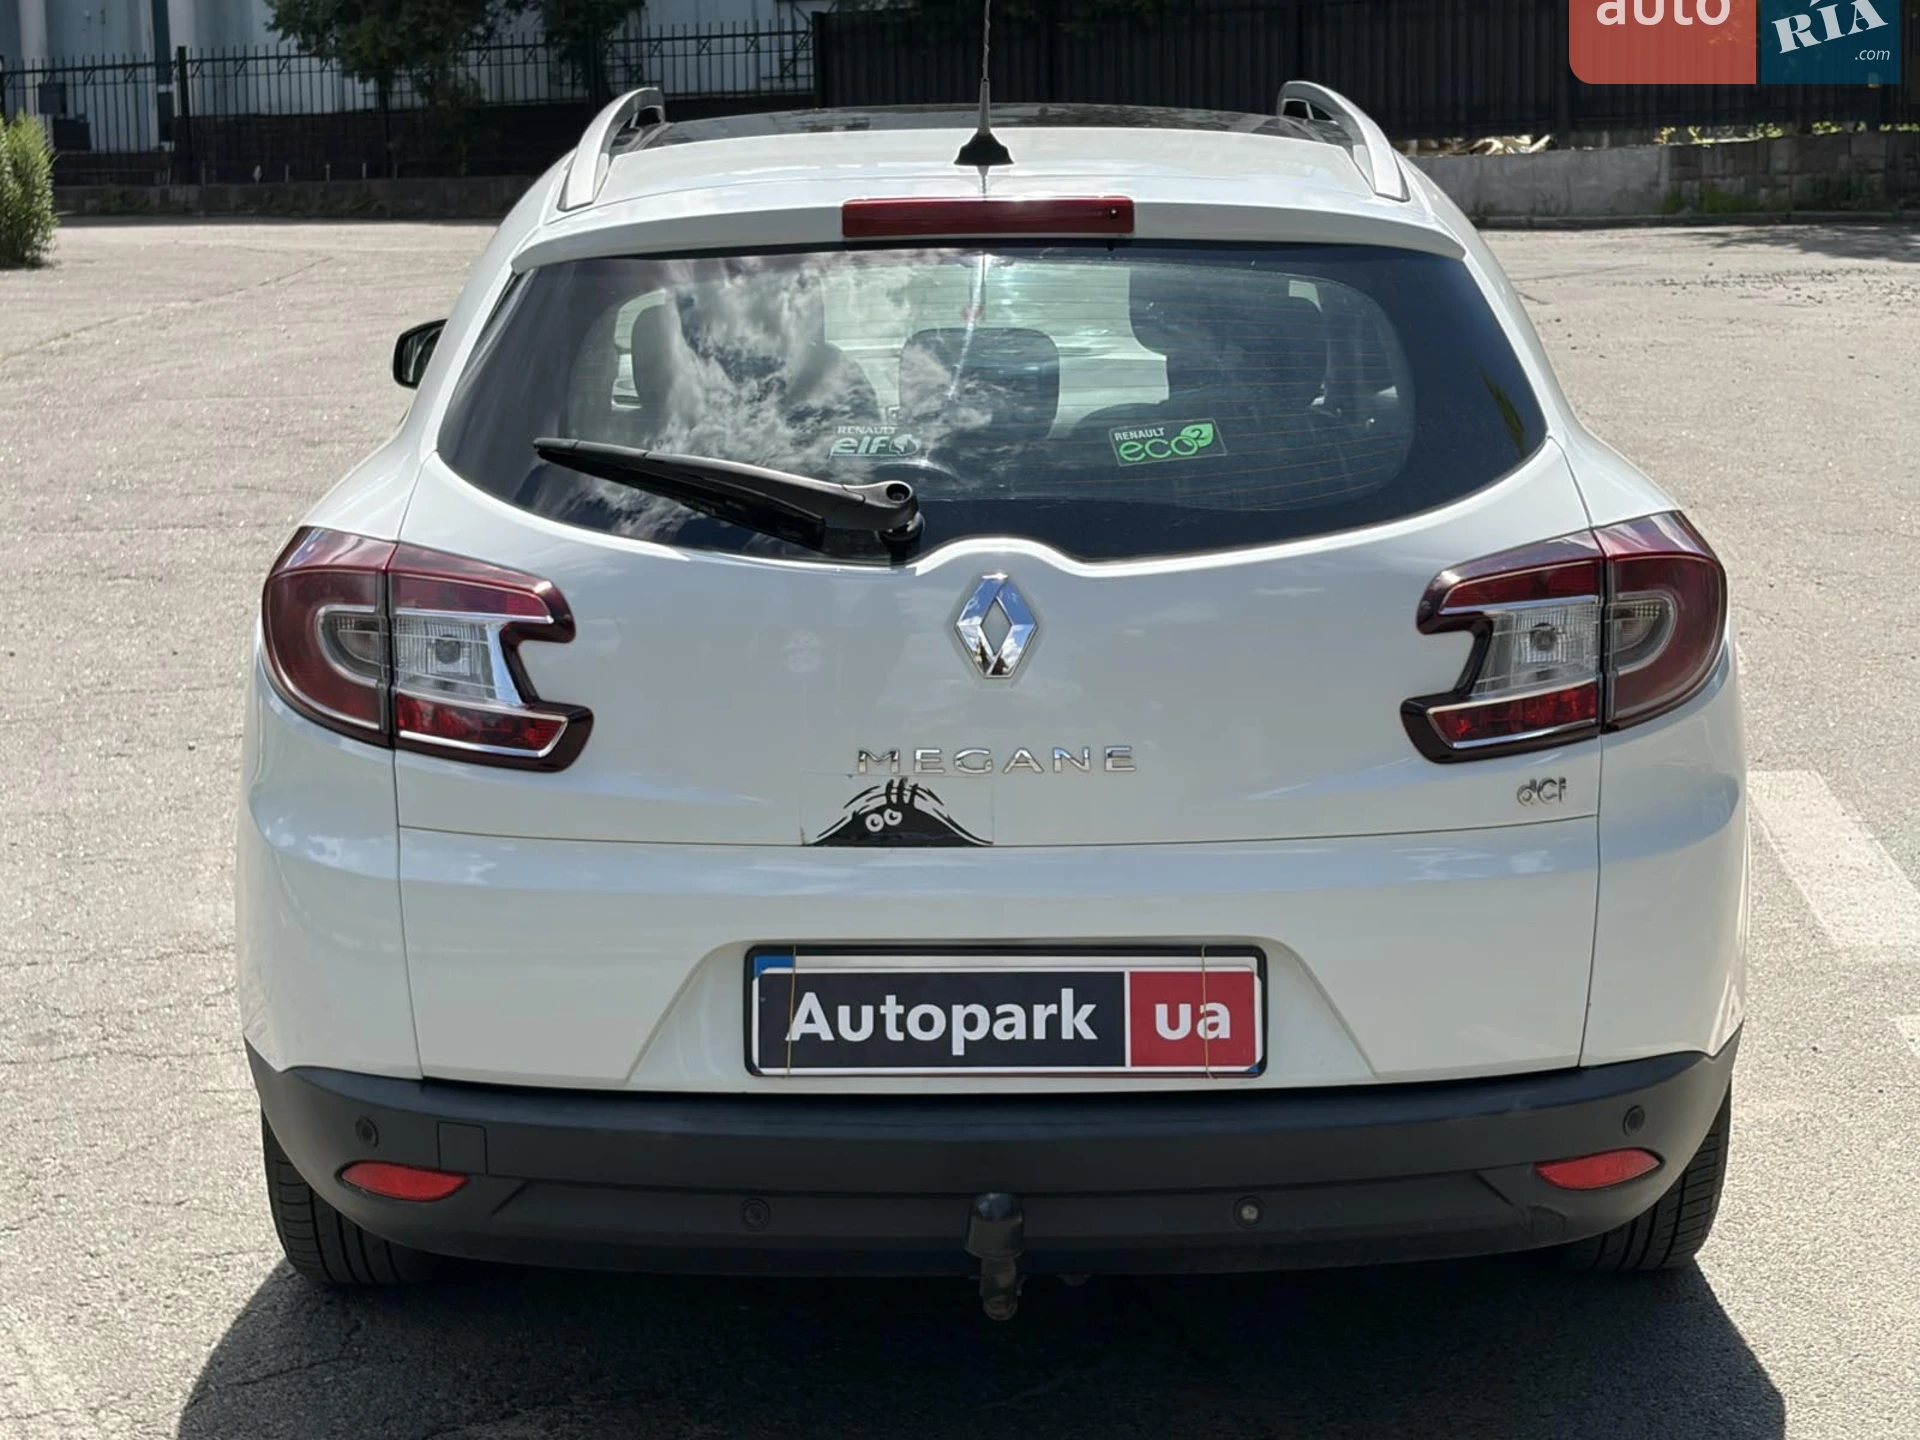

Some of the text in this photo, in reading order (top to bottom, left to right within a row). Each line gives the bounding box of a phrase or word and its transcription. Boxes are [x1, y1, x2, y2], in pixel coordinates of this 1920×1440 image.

[1114, 427, 1165, 441] RENAULT
[857, 746, 1136, 774] MEGANE
[785, 988, 1231, 1056] Autopark ua
